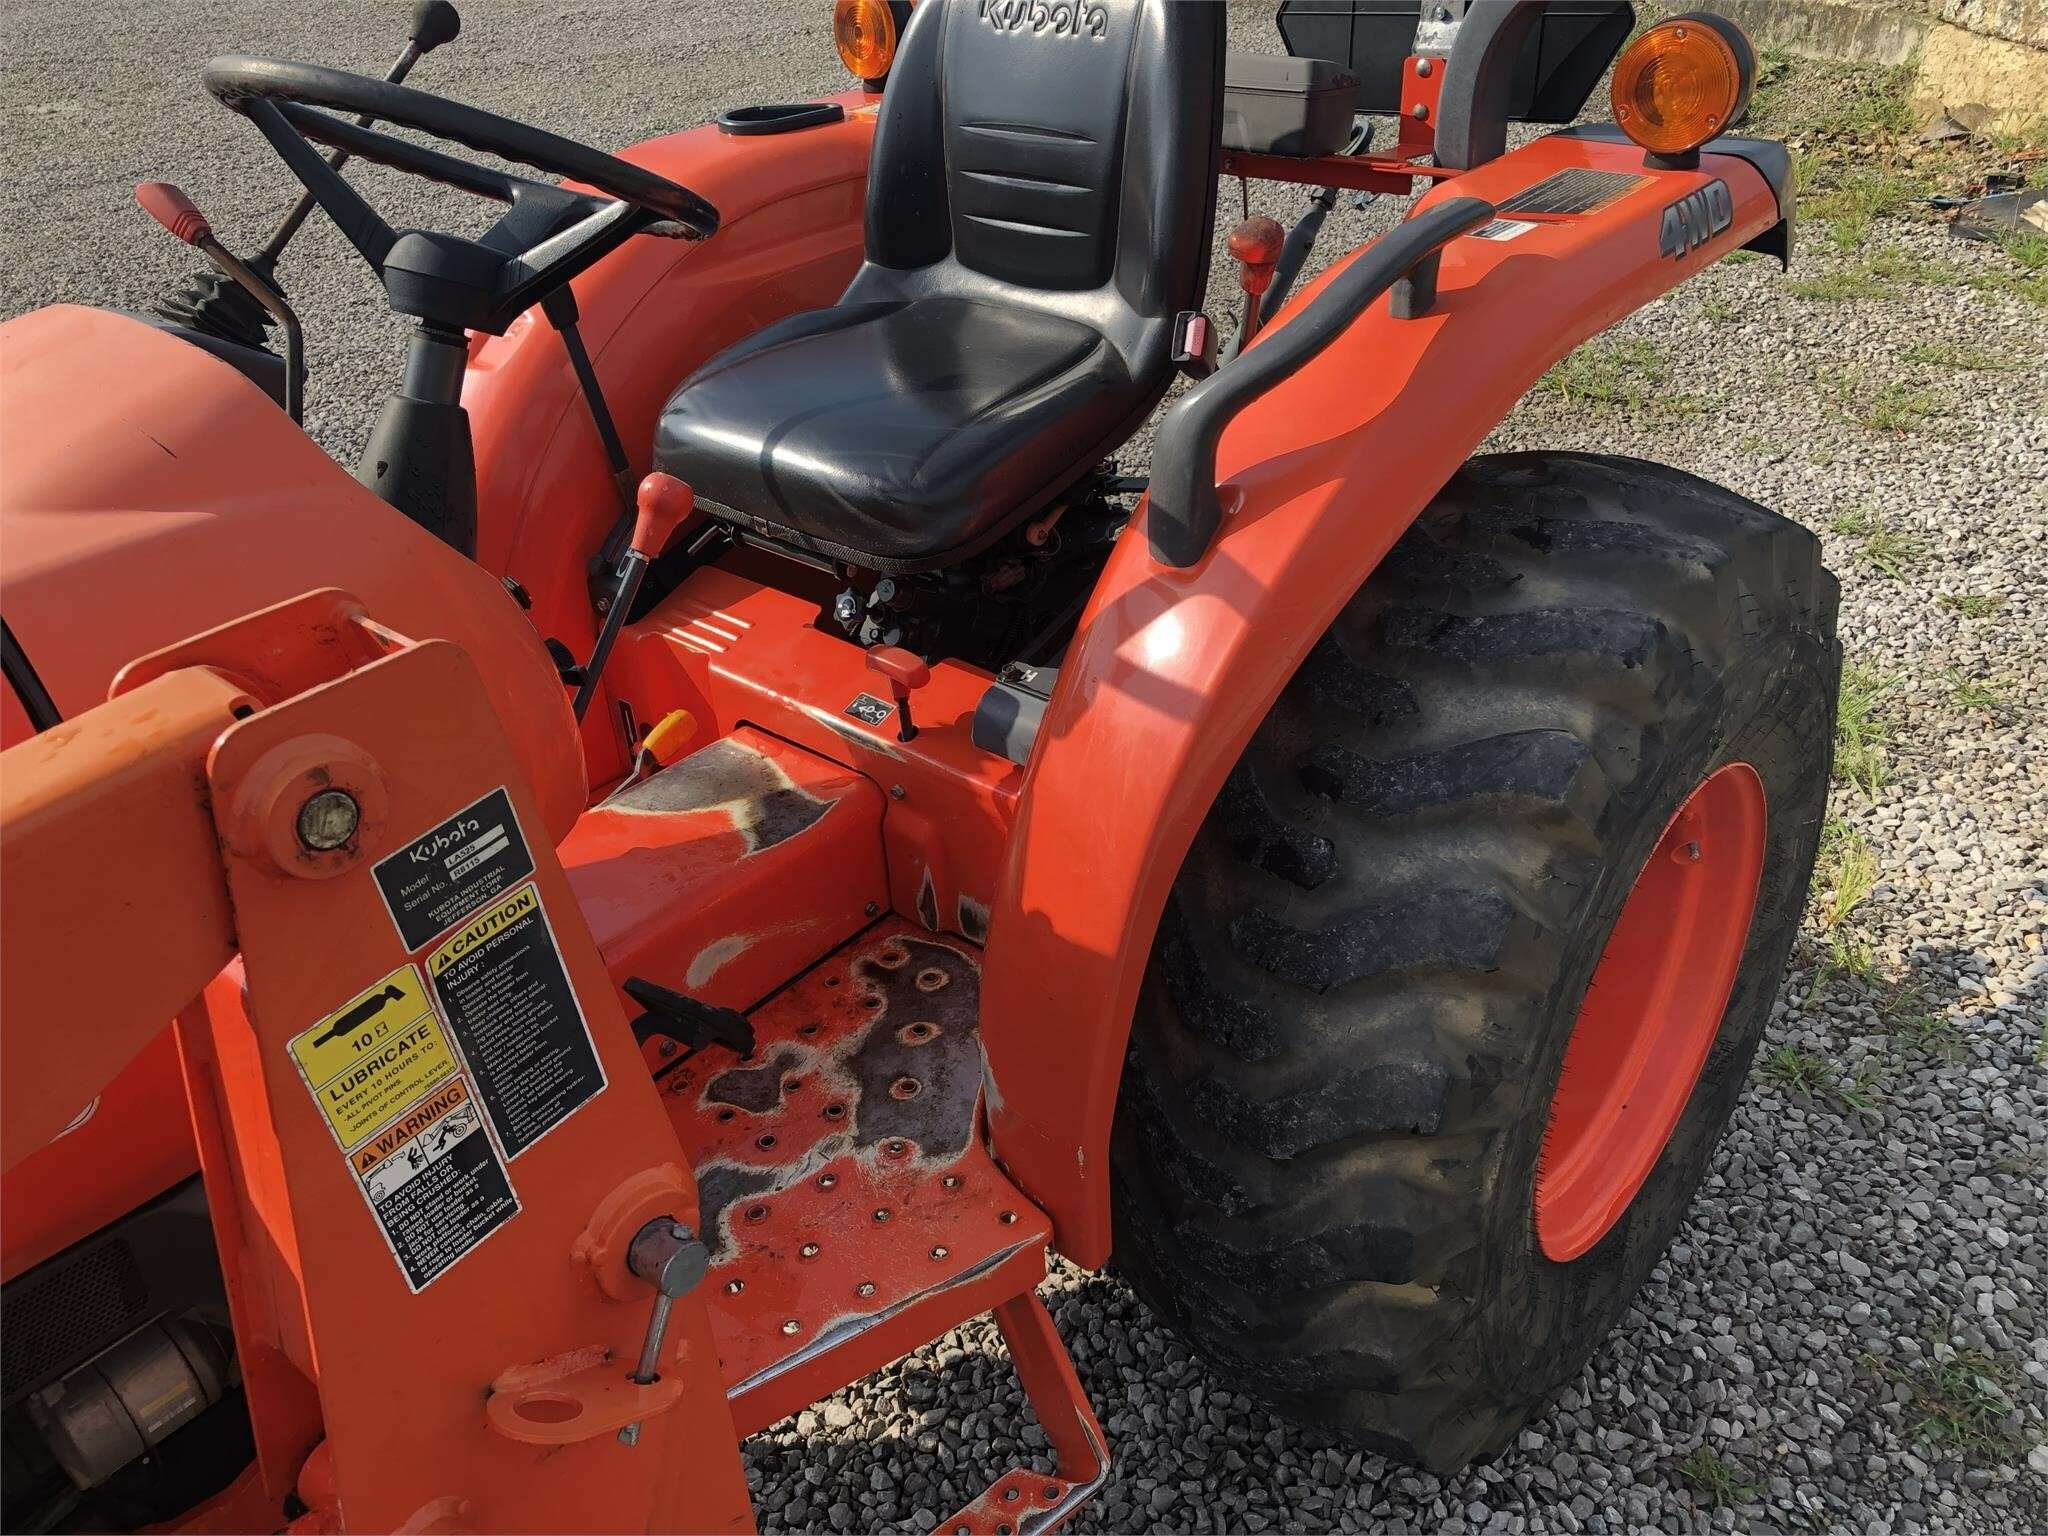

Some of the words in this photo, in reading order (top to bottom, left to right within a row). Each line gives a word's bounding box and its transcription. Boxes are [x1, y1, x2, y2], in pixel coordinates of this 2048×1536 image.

[979, 0, 1109, 39] Kubota
[1660, 178, 1733, 262] 4WD
[409, 817, 479, 863] Kubota
[448, 844, 475, 864] LA525
[403, 889, 430, 911] Serial
[431, 880, 447, 893] No.
[453, 856, 479, 877] R8115
[428, 894, 460, 918] KUBOTA
[460, 865, 504, 896] INDUSTRIAL
[435, 889, 478, 921] EQUIPMENT
[443, 967, 456, 980] TO
[457, 948, 484, 971] AVOID
[485, 916, 533, 951] PERSONAL
[451, 894, 530, 954] CAUTION
[446, 963, 478, 990] INJURY
[456, 979, 479, 997] Observe
[480, 966, 497, 981] safety
[498, 944, 529, 969] precautions
[329, 1024, 430, 1101] LUBRICATE
[351, 1032, 372, 1052] 10
[335, 1088, 367, 1115] EVERY
[384, 1052, 418, 1080] HOURS
[420, 1040, 437, 1053] TO:
[361, 1091, 382, 1109] PIVOT
[389, 1077, 424, 1103] CONTROL
[424, 1059, 447, 1078] LEVER
[375, 1087, 460, 1154] WARNING
[378, 1199, 392, 1211] TO
[394, 1178, 420, 1201] AVOID
[421, 1153, 452, 1180] INJURY
[382, 1196, 409, 1220] FROM
[410, 1175, 438, 1199] FALLS
[439, 1164, 453, 1176] OR
[386, 1203, 415, 1227] BEING
[416, 1169, 461, 1204] CRUSHED:
[409, 1207, 423, 1221] NOT
[424, 1192, 443, 1210] stand
[452, 1173, 469, 1188] work
[470, 1158, 488, 1175] under
[402, 1217, 423, 1236] raised
[423, 1201, 444, 1219] loader
[415, 1220, 429, 1234] NOT
[443, 1194, 464, 1212] loader
[416, 1247, 439, 1266] NEVER
[439, 1226, 465, 1249] connect
[486, 1196, 503, 1212] cable
[421, 1232, 435, 1246] NOT
[449, 1206, 469, 1224] loader
[428, 1252, 444, 1266] rope
[452, 1229, 472, 1247] loader
[473, 1210, 495, 1230] bucket
[495, 1197, 512, 1212] while
[407, 1235, 423, 1250] jack
[414, 1245, 431, 1260] work
[423, 1252, 454, 1278] operating
